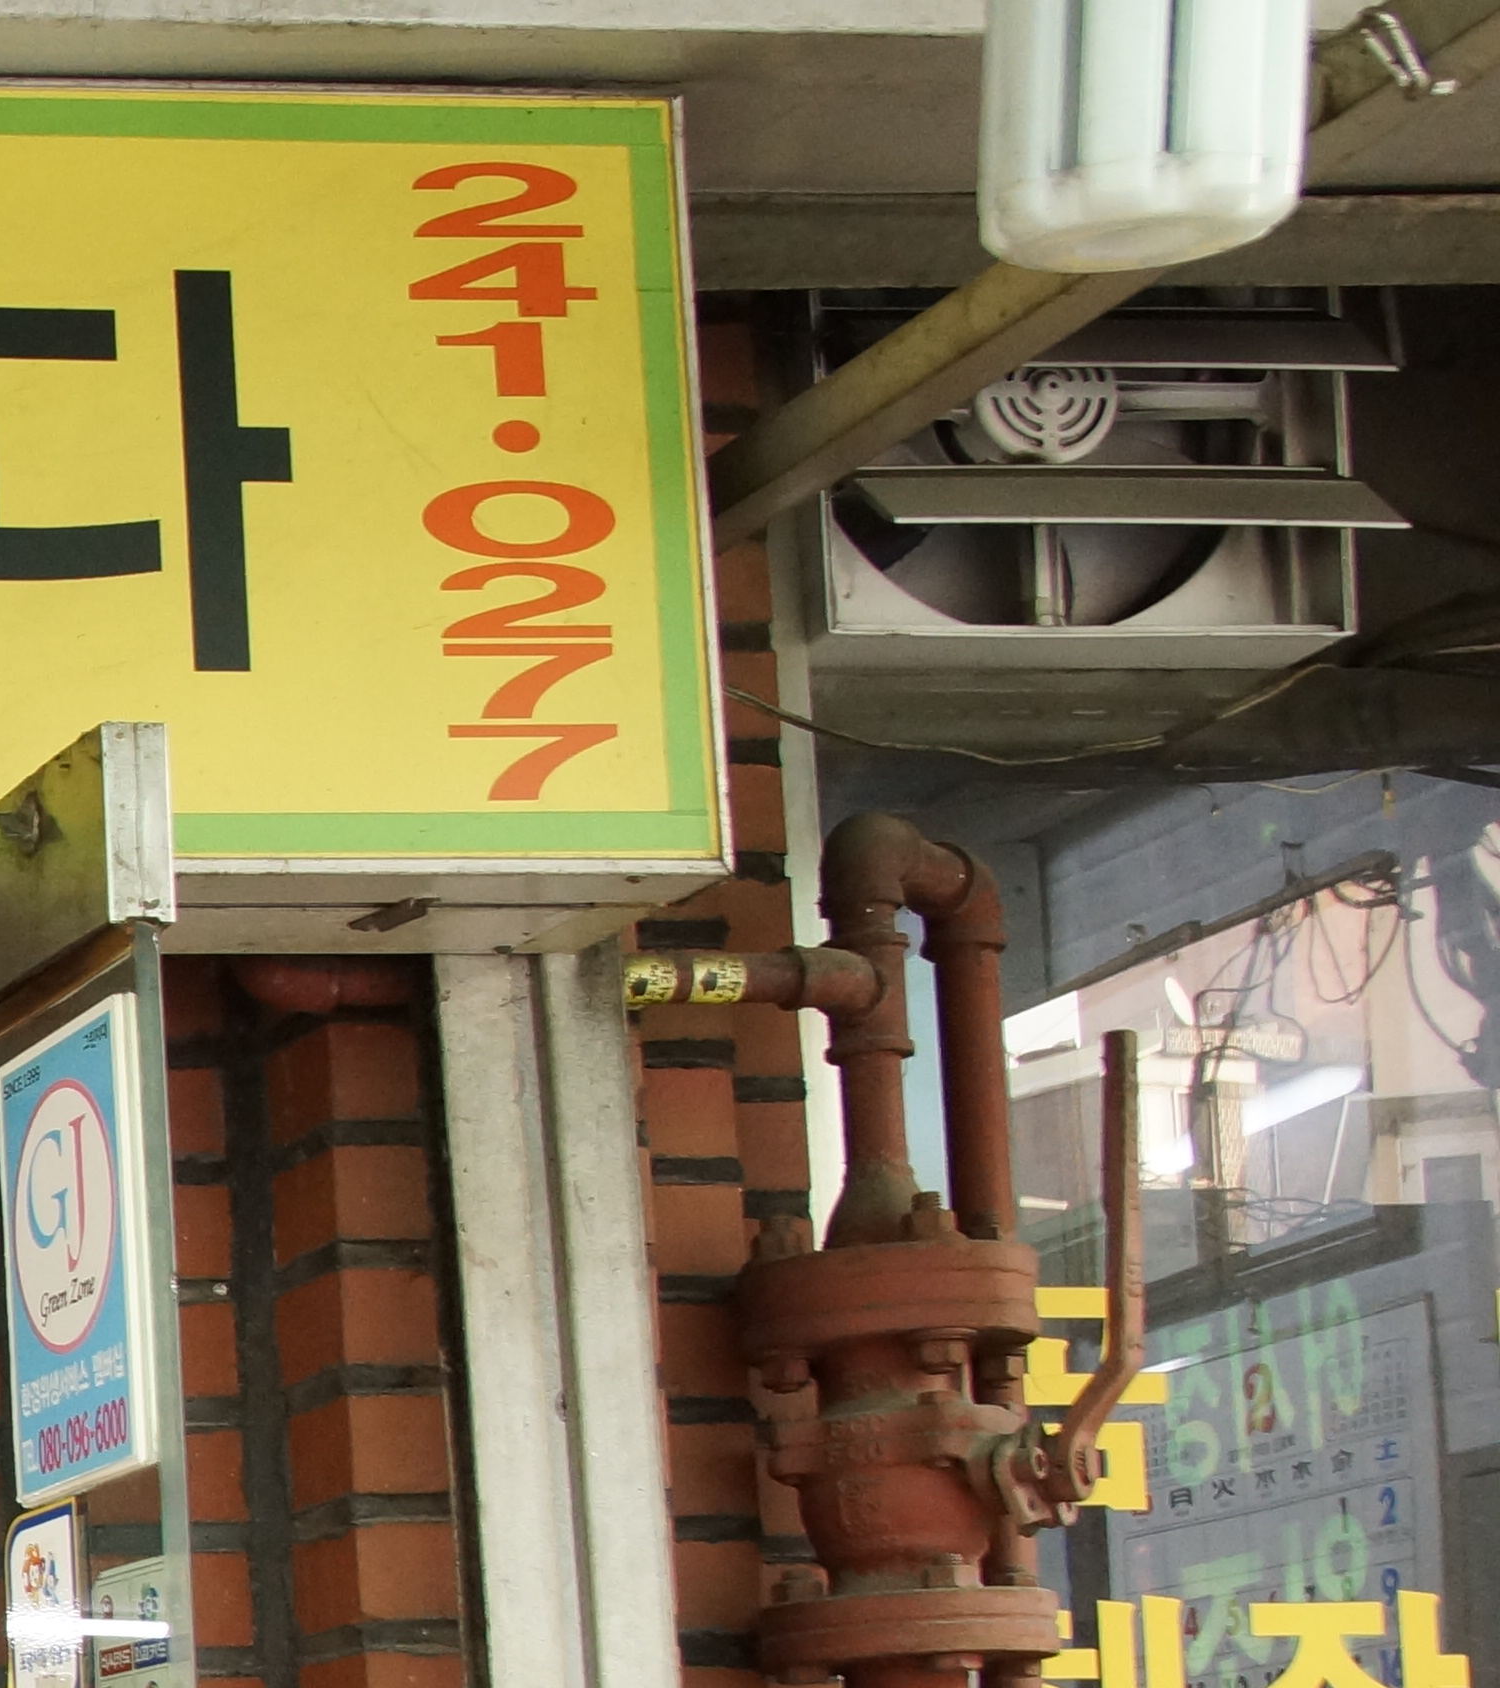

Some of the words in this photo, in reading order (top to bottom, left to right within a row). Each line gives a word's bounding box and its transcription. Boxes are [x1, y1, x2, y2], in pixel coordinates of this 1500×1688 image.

[25, 1113, 87, 1272] GJ
[40, 1286, 67, 1327] Green
[69, 1274, 96, 1304] Zone
[38, 1396, 128, 1475] 080-096-6000
[1378, 1486, 1397, 1526] 2
